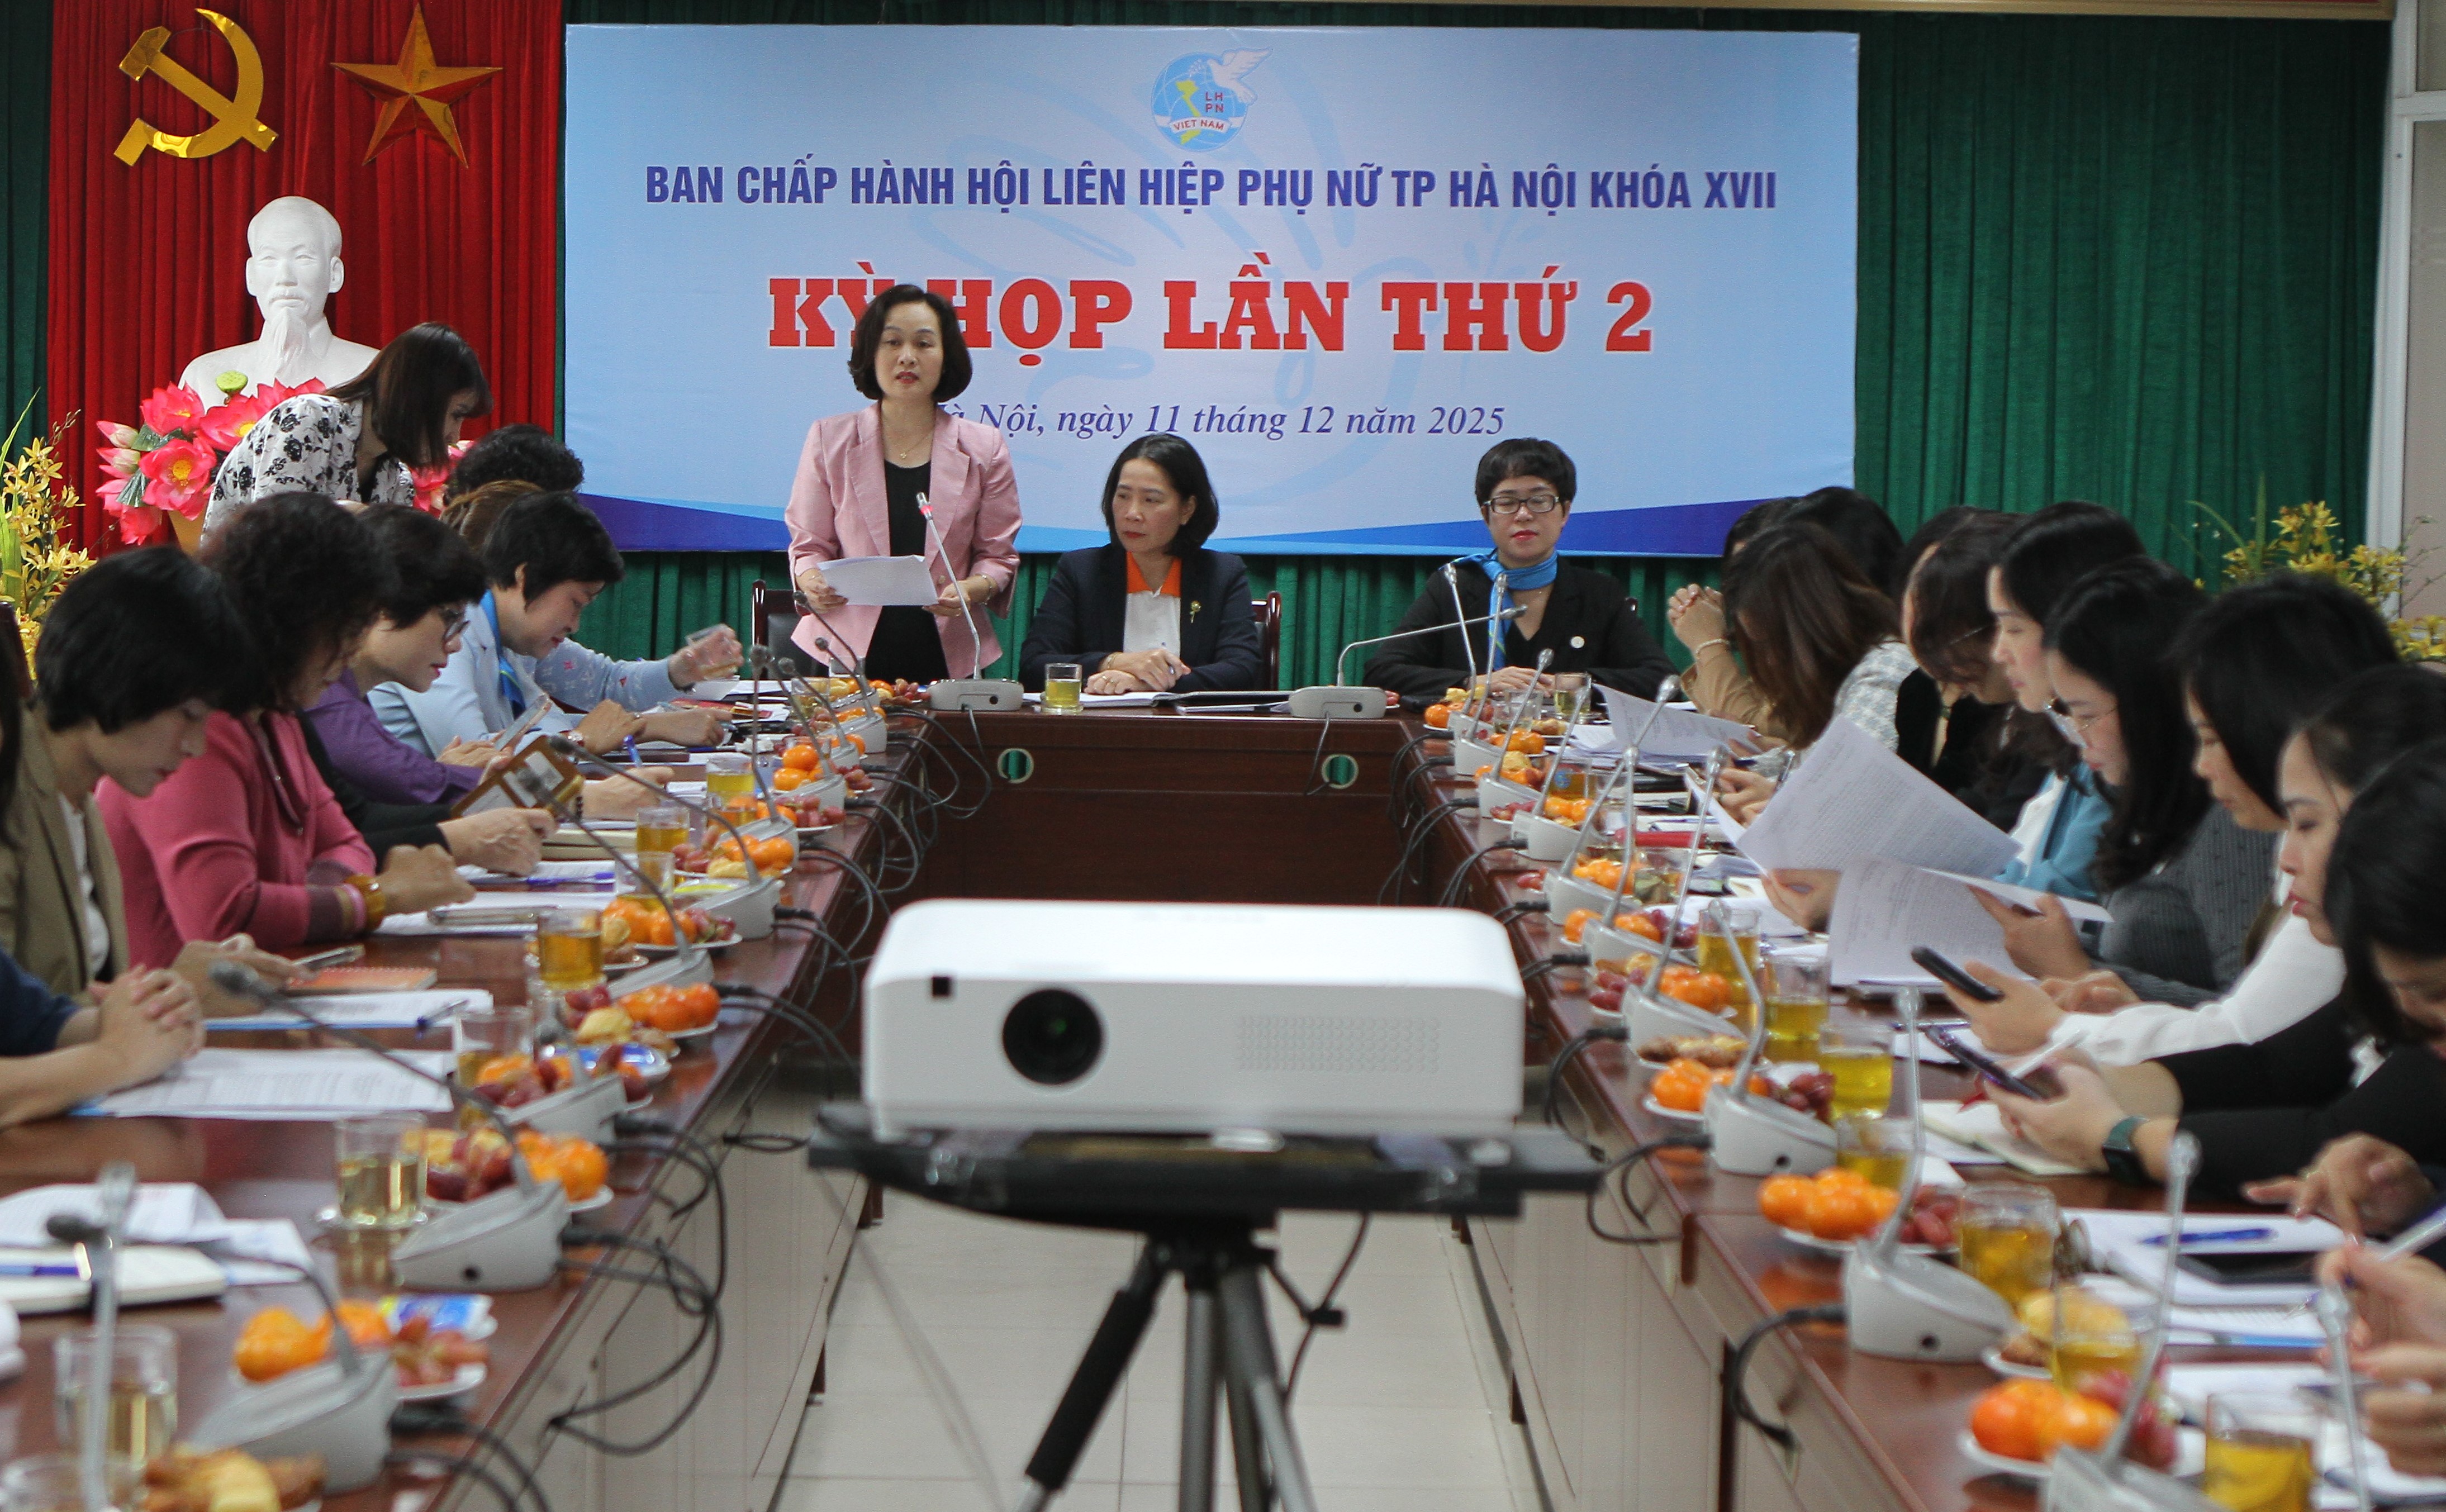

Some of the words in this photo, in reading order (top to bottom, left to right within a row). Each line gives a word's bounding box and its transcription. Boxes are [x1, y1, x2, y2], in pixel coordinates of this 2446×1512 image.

[1206, 92, 1223, 101] LH
[1206, 104, 1223, 112] PN
[1174, 120, 1196, 130] VIET
[1201, 120, 1224, 130] NAM
[646, 166, 723, 203] BAN
[738, 153, 837, 203] CHẤP
[851, 159, 954, 205] HÀNH
[968, 160, 1029, 213] HỘI
[1043, 160, 1125, 205] LIÊN
[1140, 161, 1224, 214] HIỆP
[1238, 169, 1312, 215] PHỤ
[1327, 163, 1383, 207] NỮ
[1391, 170, 1436, 207] TP
[1450, 163, 1499, 207] HÀ
[1513, 163, 1576, 216] NỘI
[1591, 163, 1692, 208] KHÓA
[1704, 172, 1776, 208] XVII
[927, 279, 1132, 367] HỌP
[1164, 252, 1348, 351] LẦN
[1381, 266, 1577, 352] THỨ
[1606, 282, 1651, 351] 2
[980, 403, 1044, 438] Nội,
[1057, 404, 1133, 439] ngày
[1145, 405, 1180, 432] 11
[1193, 405, 1287, 440] tháng
[1298, 406, 1334, 433] 12
[1346, 406, 1416, 434] năm
[1427, 406, 1505, 435] 2025
